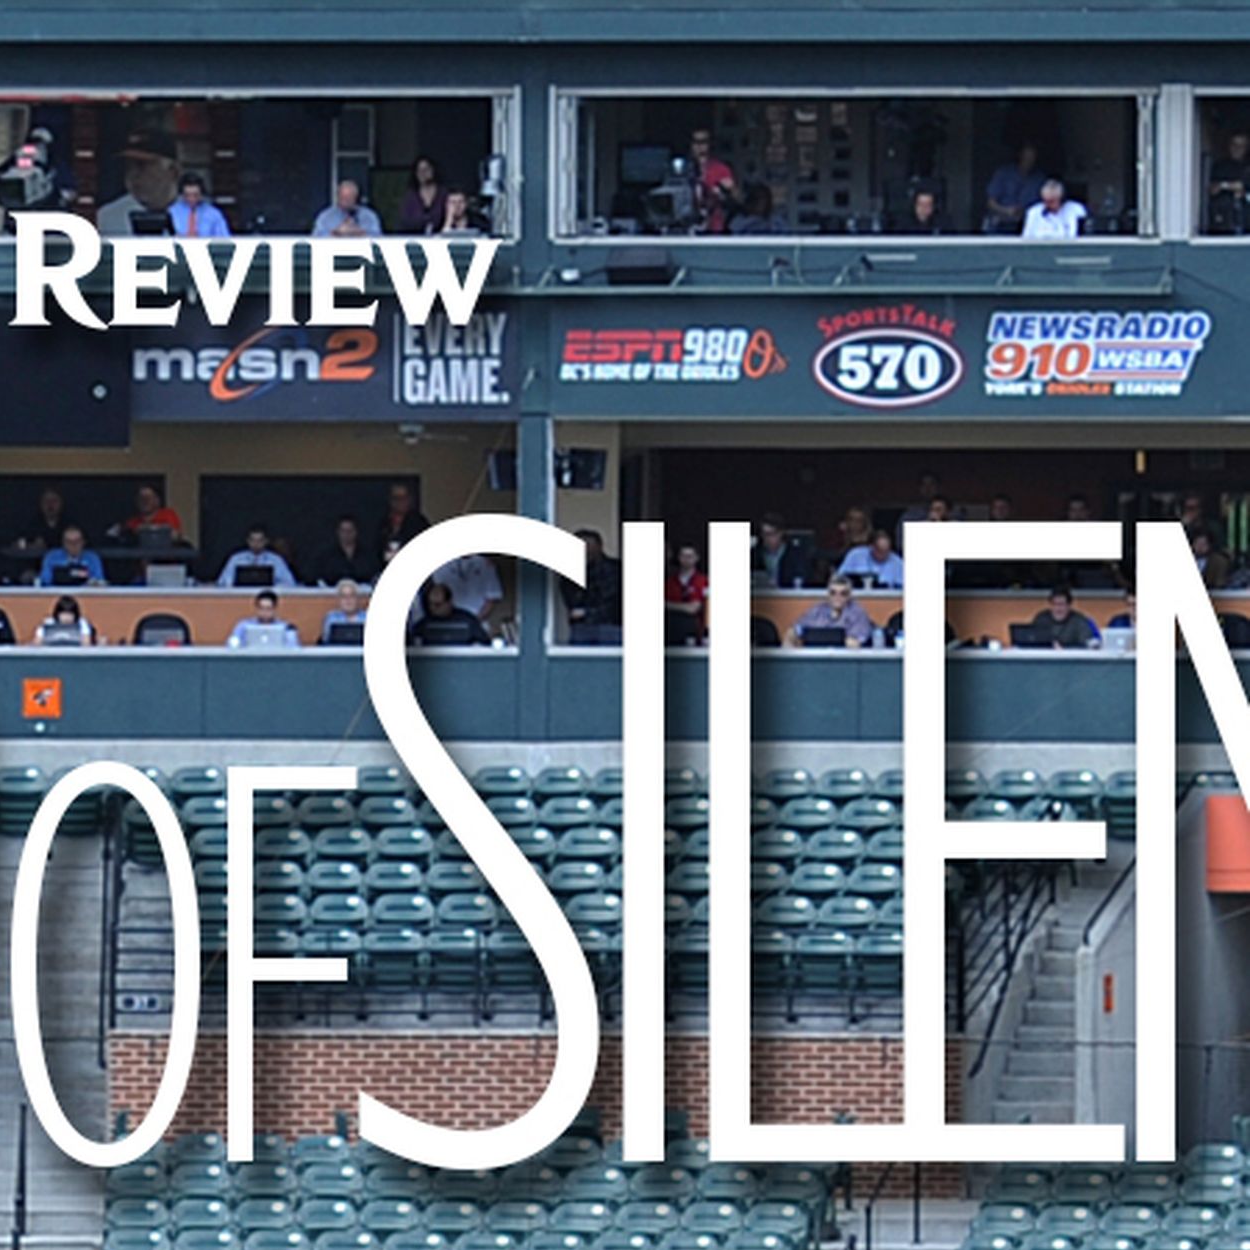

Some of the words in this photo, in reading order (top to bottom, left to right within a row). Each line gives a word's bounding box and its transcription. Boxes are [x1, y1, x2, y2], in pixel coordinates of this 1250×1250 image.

[991, 314, 1208, 340] NEWSRADIO
[403, 357, 509, 404] GAME.
[837, 344, 942, 390] 570
[989, 342, 1091, 378] 910
[1097, 350, 1184, 370] WSBA
